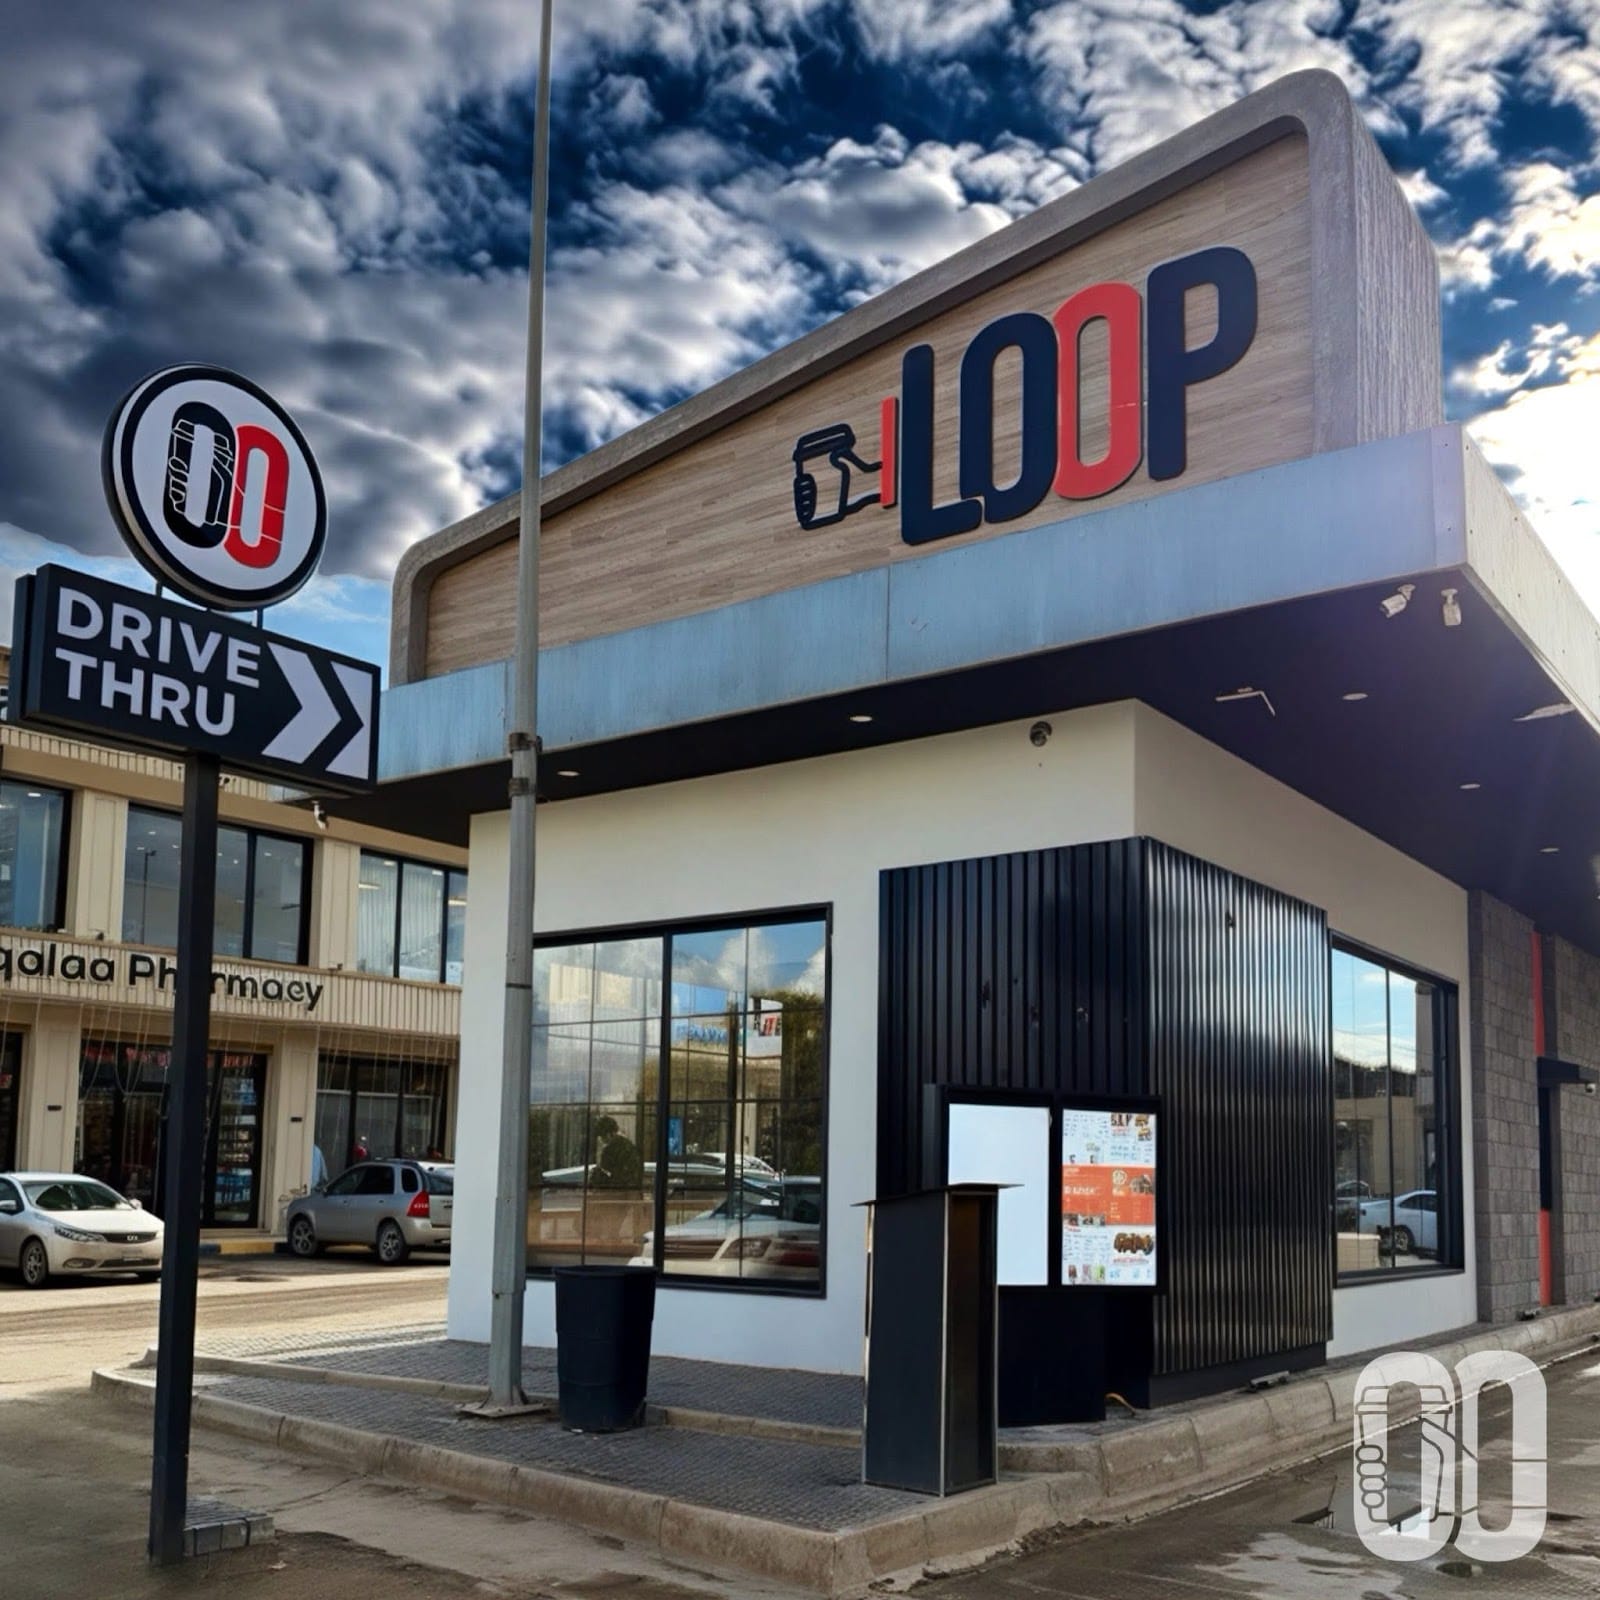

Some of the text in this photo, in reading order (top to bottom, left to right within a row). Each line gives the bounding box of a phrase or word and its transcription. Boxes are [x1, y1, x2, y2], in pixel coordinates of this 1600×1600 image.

[902, 246, 1258, 545] LOOP
[56, 586, 262, 689] DRIVE
[55, 647, 236, 737] THRU
